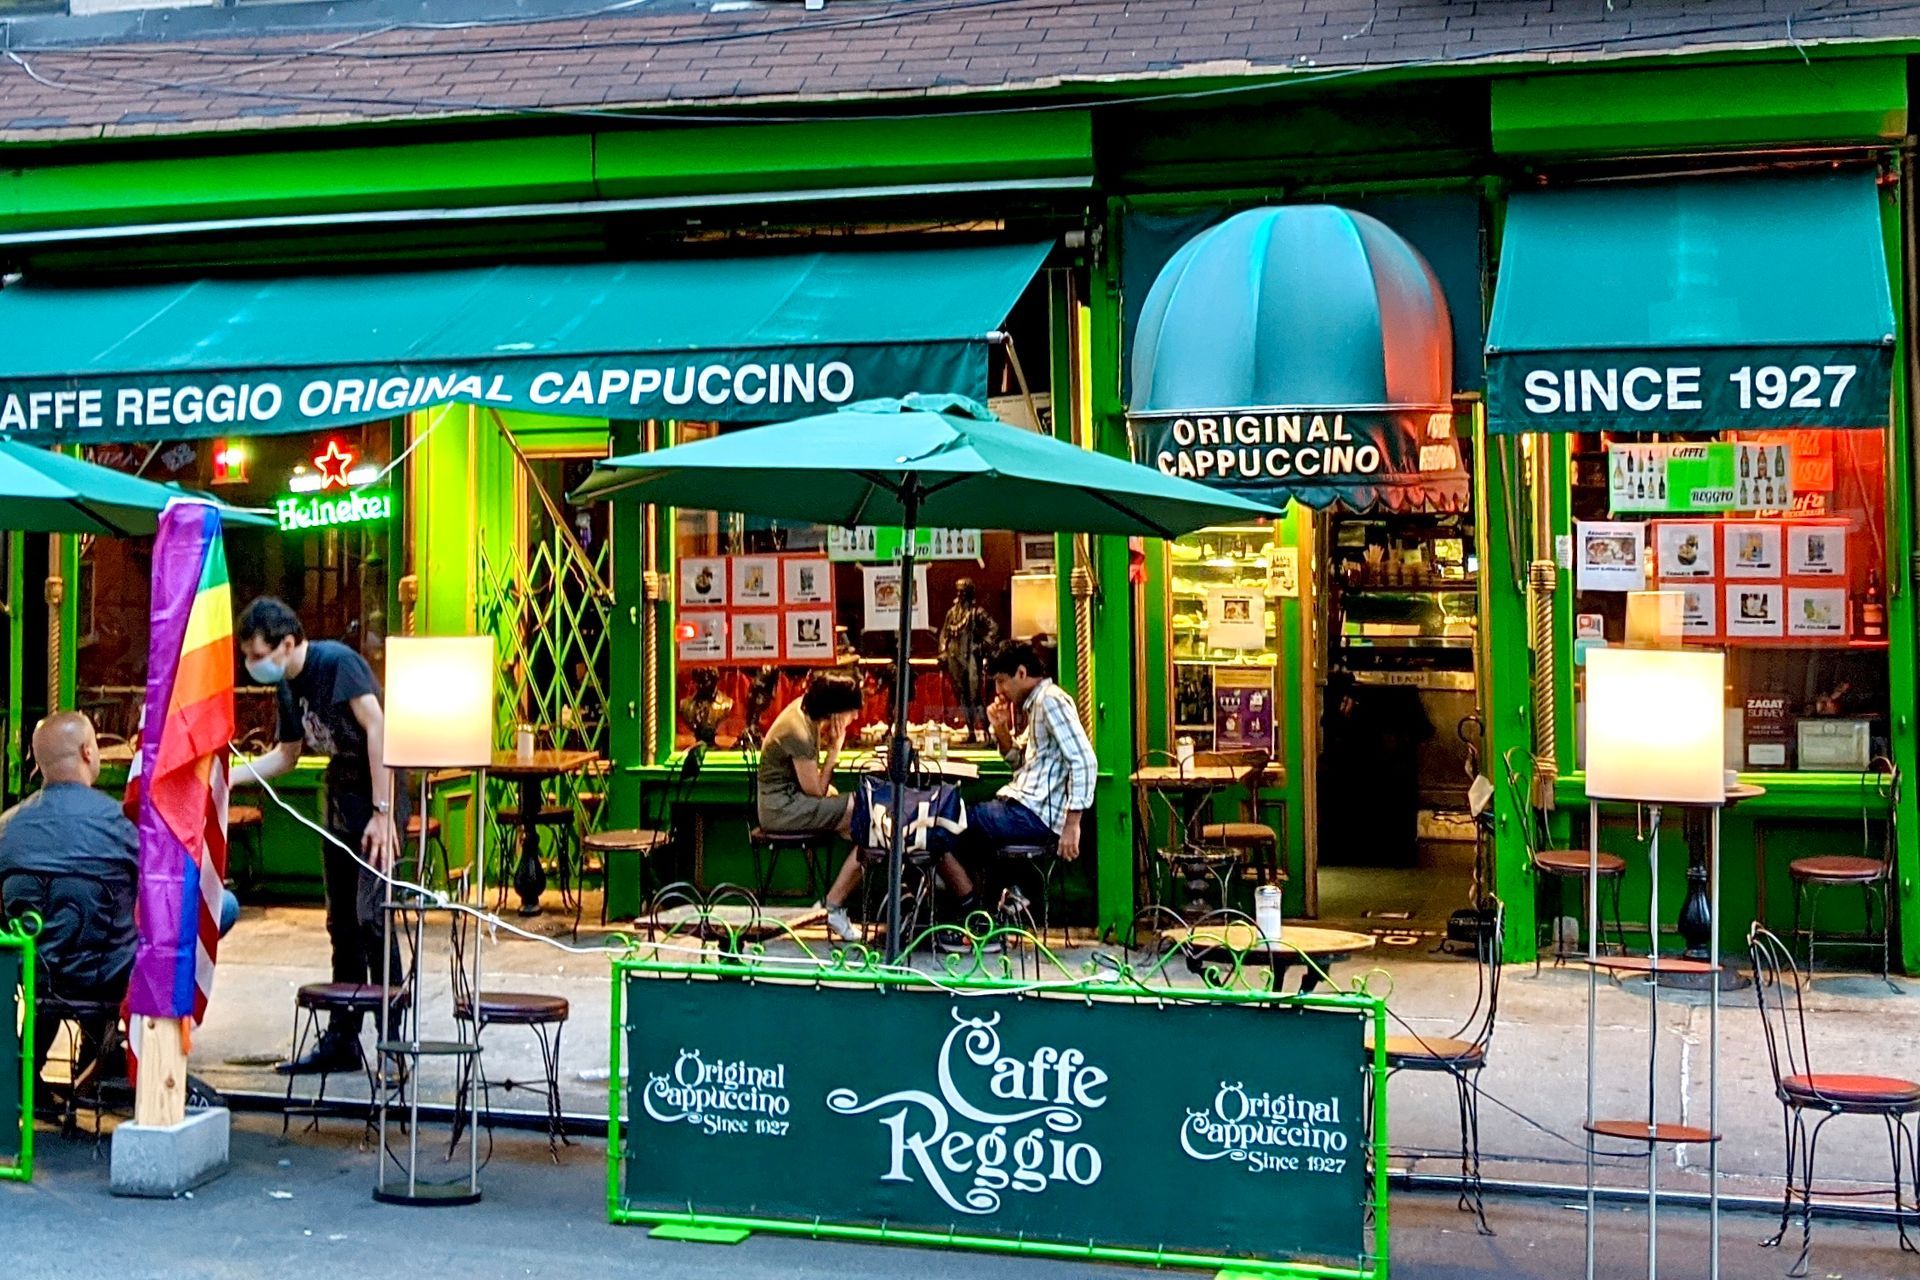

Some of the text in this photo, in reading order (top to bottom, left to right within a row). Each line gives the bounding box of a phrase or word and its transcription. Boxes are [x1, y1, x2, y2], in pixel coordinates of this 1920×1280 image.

[0, 361, 856, 431] AFFE REGGIO ORIGINAL CAPPUCCINO
[1525, 366, 1857, 413] SINCE 1927
[1173, 415, 1352, 446] ORIGINAL
[1157, 445, 1380, 478] CAPPUCCINO
[1747, 699, 1785, 709] ZAGAT
[1748, 709, 1785, 718] SURVEY
[674, 1048, 785, 1091] Original
[938, 1006, 1109, 1133] Caffe
[643, 1072, 790, 1123] Cappuccino
[1215, 1081, 1340, 1125] Original
[703, 1114, 790, 1136] Since 1927
[1180, 1107, 1348, 1161] Cappuccino
[826, 1088, 1102, 1214] Reggio
[1248, 1151, 1347, 1173] Since 1927
